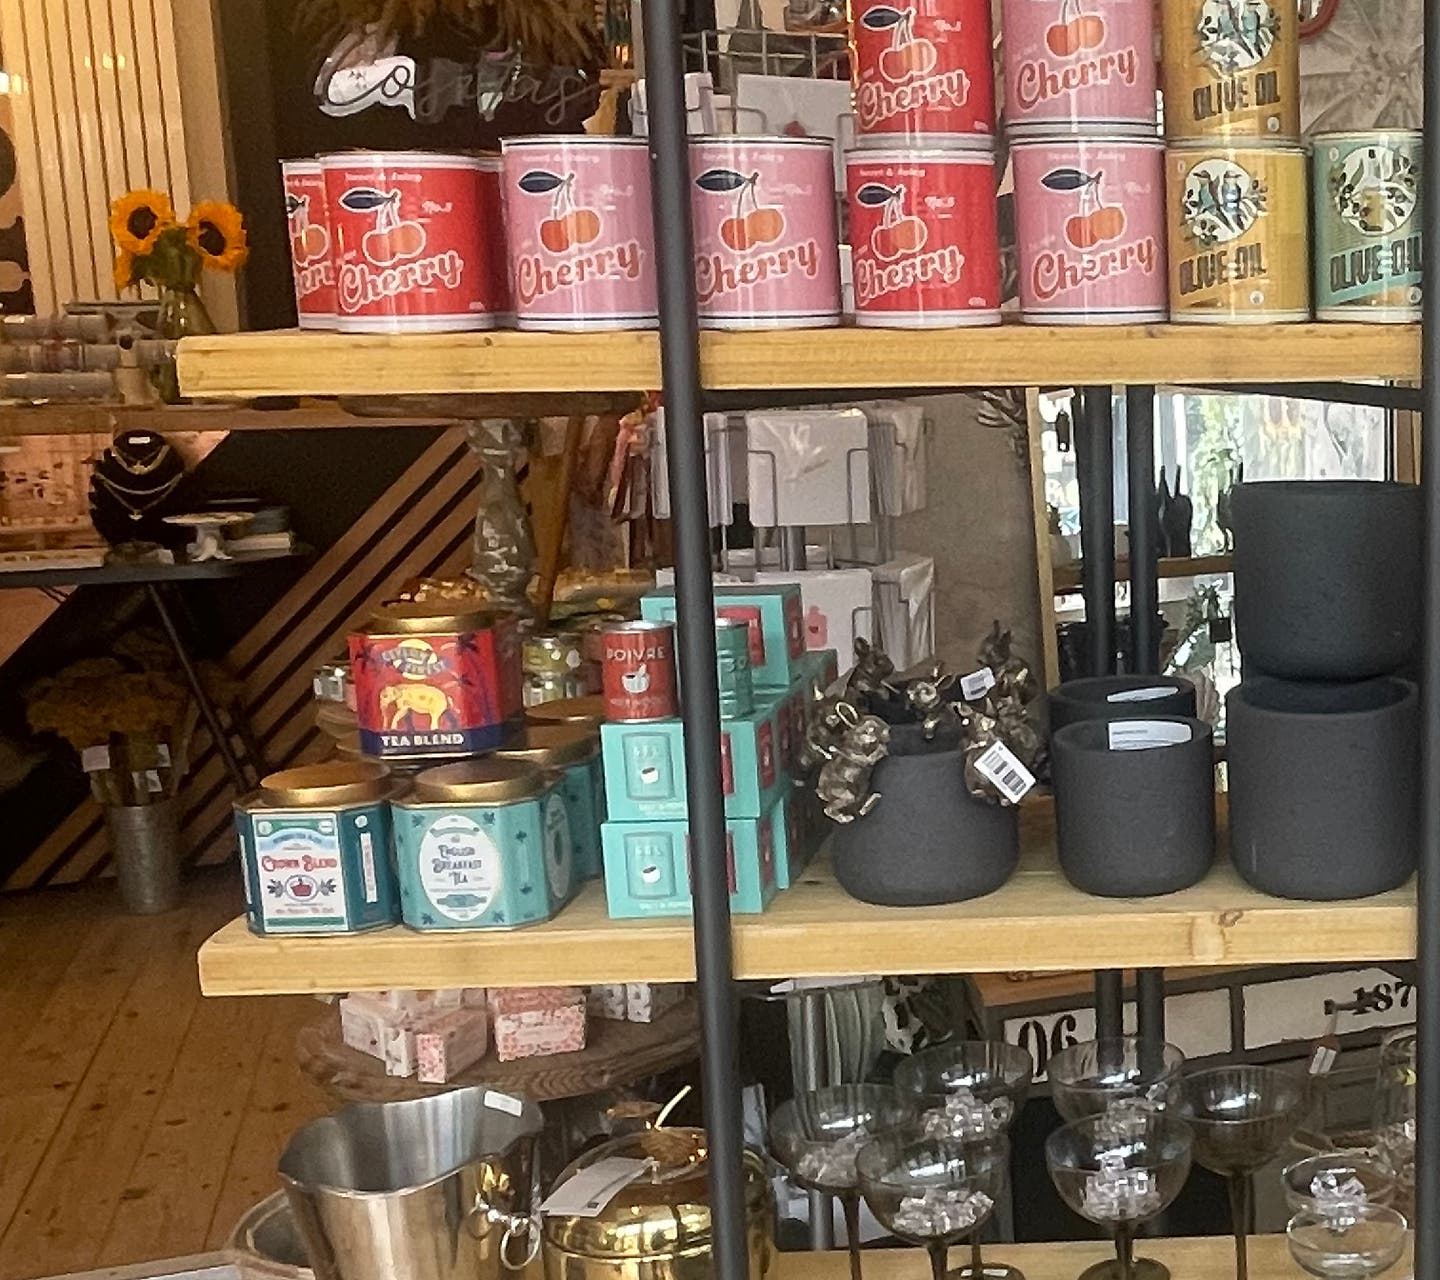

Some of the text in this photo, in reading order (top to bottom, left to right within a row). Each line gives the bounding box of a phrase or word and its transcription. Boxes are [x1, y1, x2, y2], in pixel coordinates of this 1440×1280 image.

[858, 69, 971, 130] Cherry
[1016, 44, 1139, 112] Cherry
[1193, 70, 1281, 121] OLIVE OIL
[336, 250, 465, 313] Cherry
[517, 241, 645, 306] Cherry
[697, 240, 820, 304] Cherry
[855, 245, 965, 308] Cherry
[1031, 236, 1157, 302] Cherry
[1179, 242, 1267, 296] OLIVE OIL
[1329, 243, 1383, 294] OLIVE
[606, 646, 665, 662] POIVRE
[380, 733, 465, 748] TEA BLEND
